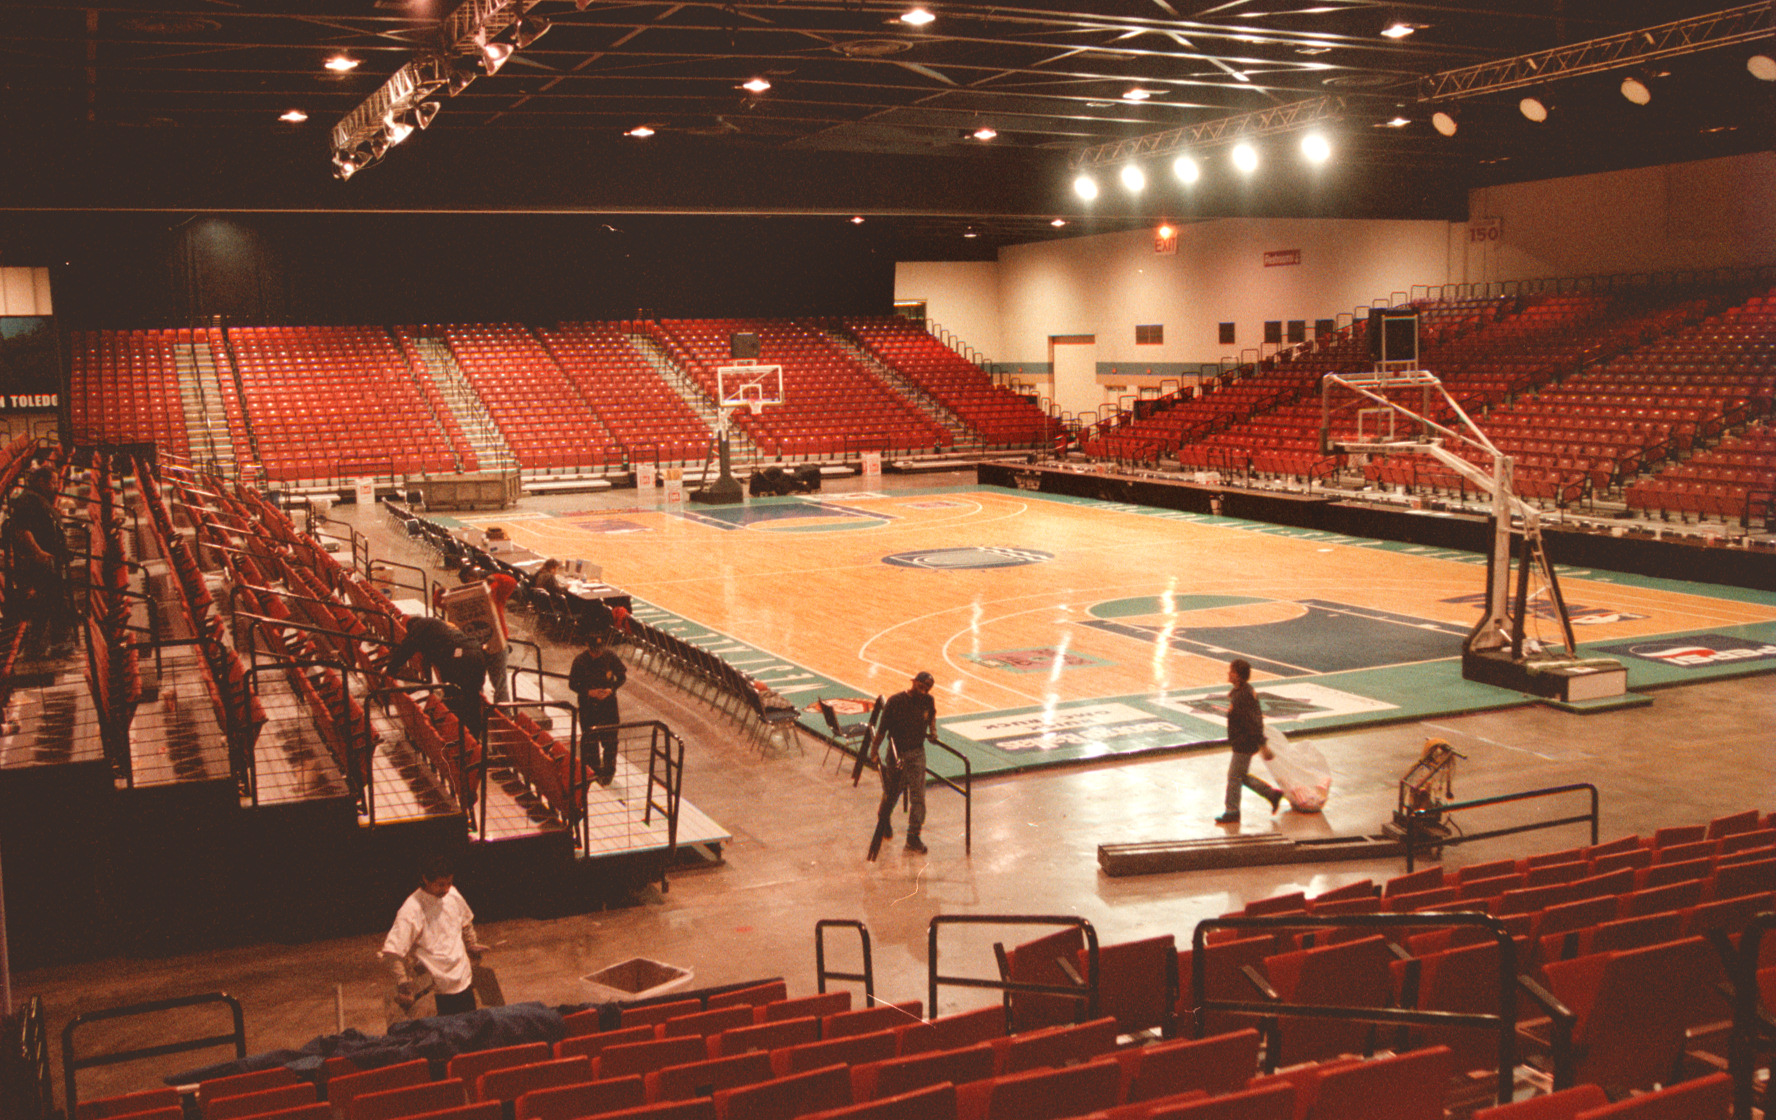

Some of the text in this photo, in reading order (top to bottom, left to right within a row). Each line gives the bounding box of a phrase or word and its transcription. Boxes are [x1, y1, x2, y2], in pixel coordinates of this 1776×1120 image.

[1470, 227, 1498, 241] 150
[1155, 238, 1176, 252] EXIT
[10, 394, 58, 408] TOLEDO
[985, 718, 1050, 731] RUCK
